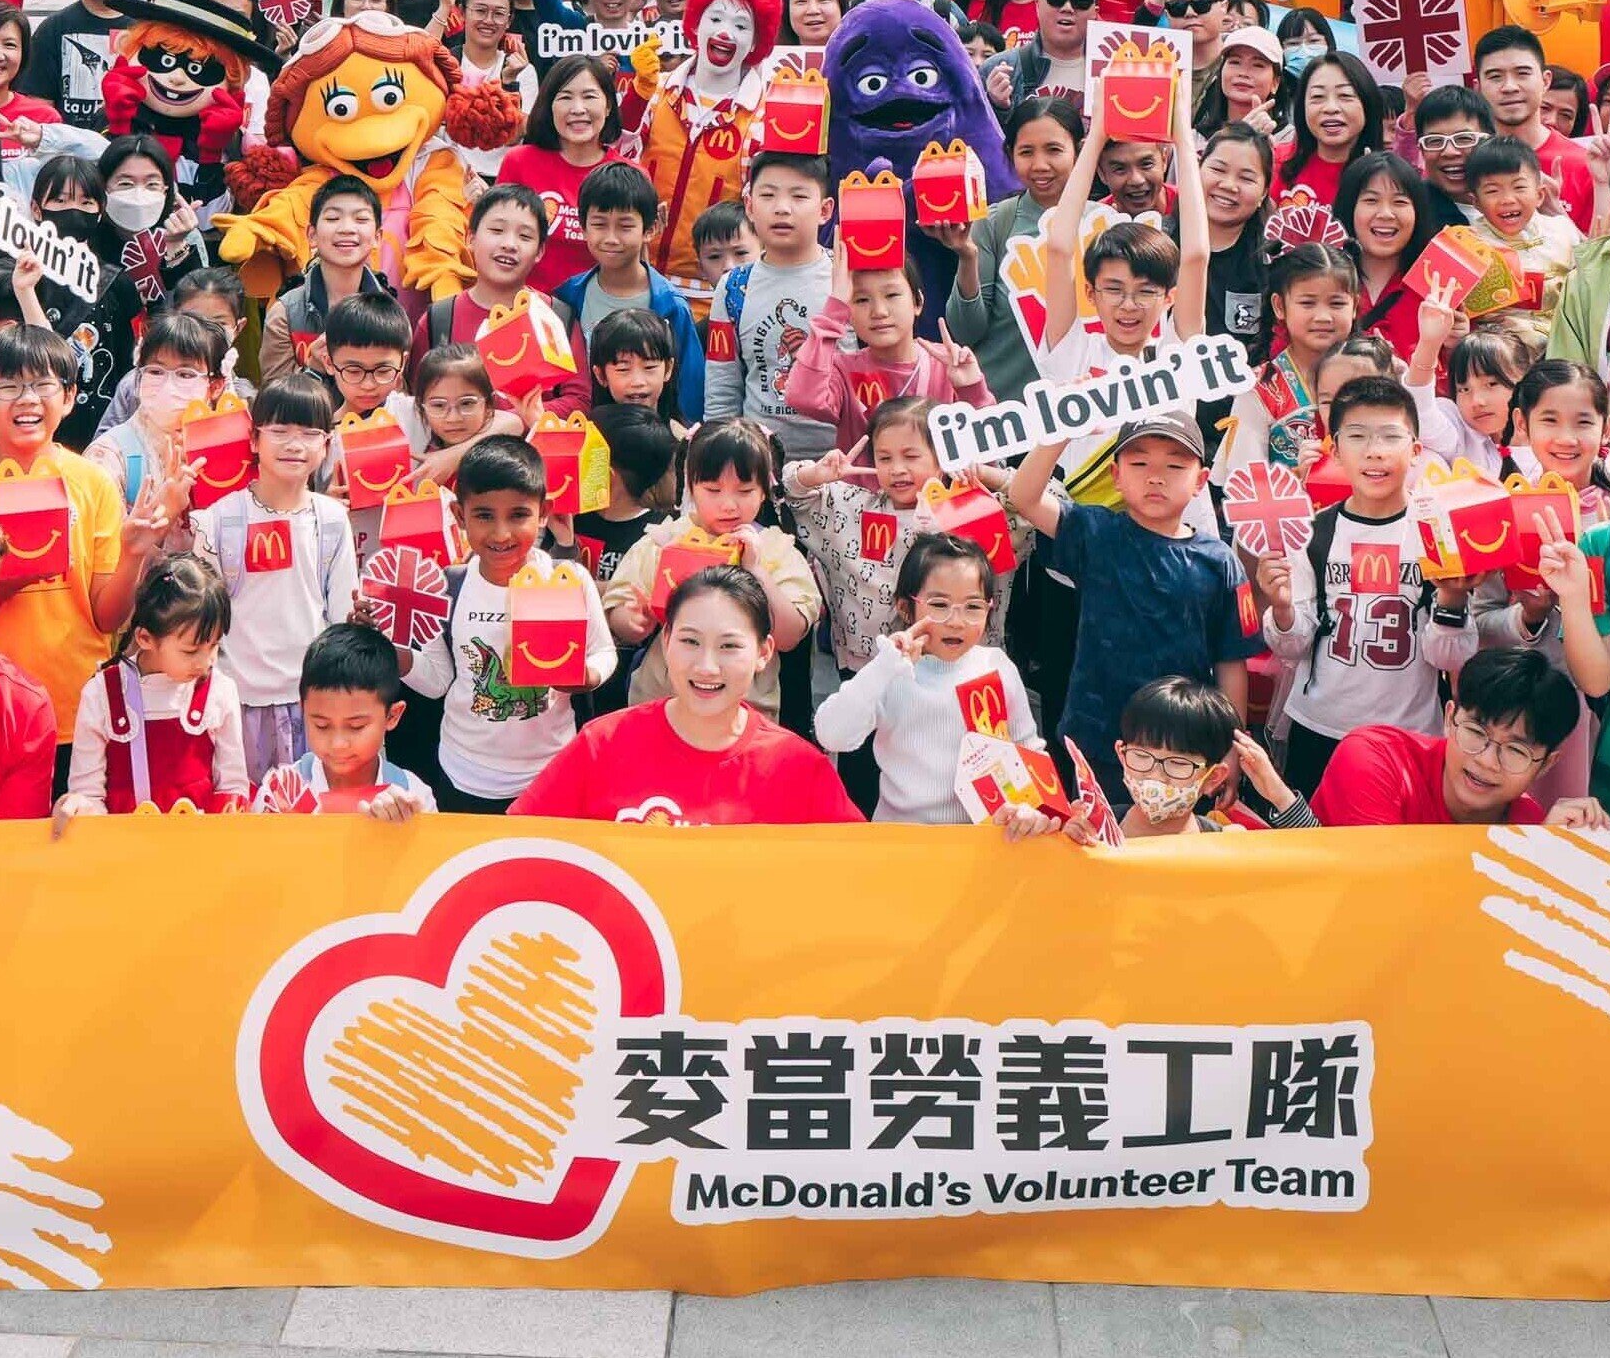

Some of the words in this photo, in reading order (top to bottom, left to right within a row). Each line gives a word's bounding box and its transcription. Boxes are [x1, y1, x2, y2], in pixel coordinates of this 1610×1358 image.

[543, 29, 583, 53] i'm
[3, 207, 75, 277] lovin'
[78, 252, 96, 293] it
[938, 412, 1028, 461] i'm
[1035, 353, 1183, 434] lovin'
[1196, 344, 1246, 390] it
[469, 611, 507, 623] PIZZ
[1328, 593, 1417, 670] 13
[615, 1030, 1359, 1152] 麥當勞義工隊
[687, 1171, 971, 1212] McDonald's
[984, 1164, 1216, 1206] Volunteer
[1226, 1157, 1357, 1200] Team
